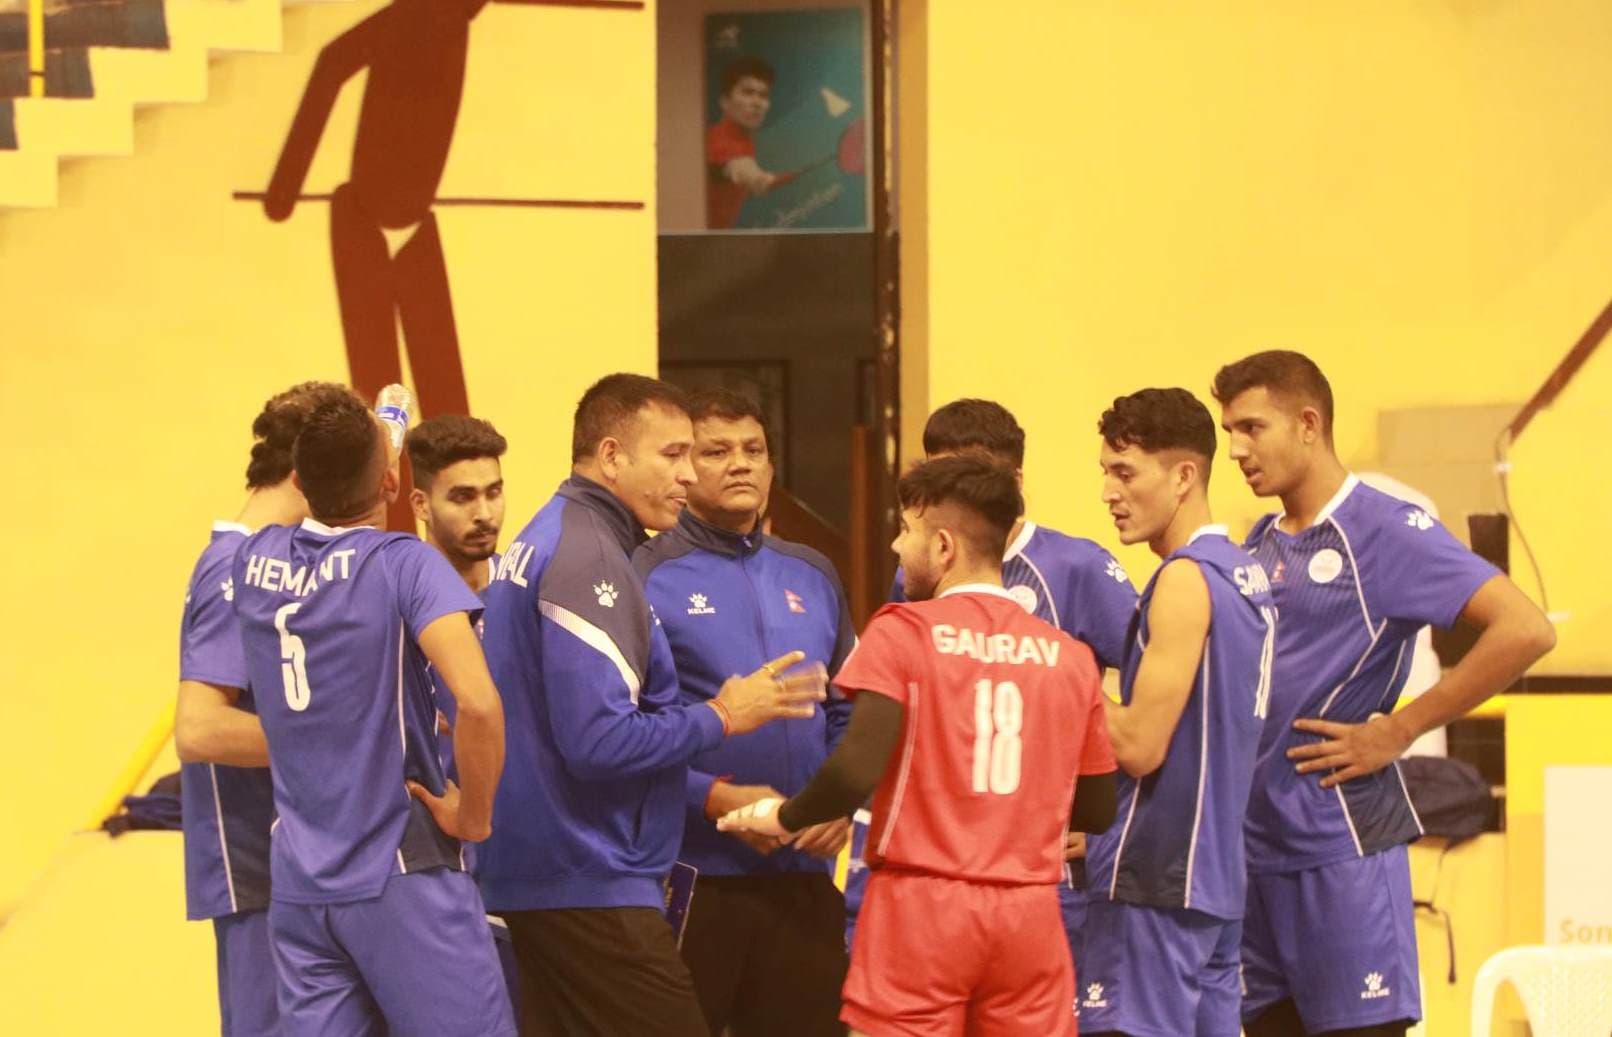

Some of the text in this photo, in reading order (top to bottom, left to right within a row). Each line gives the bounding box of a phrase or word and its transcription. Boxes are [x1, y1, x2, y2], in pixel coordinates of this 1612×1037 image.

[245, 549, 356, 596] HEMANT
[274, 602, 311, 712] 5
[931, 624, 1060, 667] GAURAV
[972, 678, 1024, 795] 18
